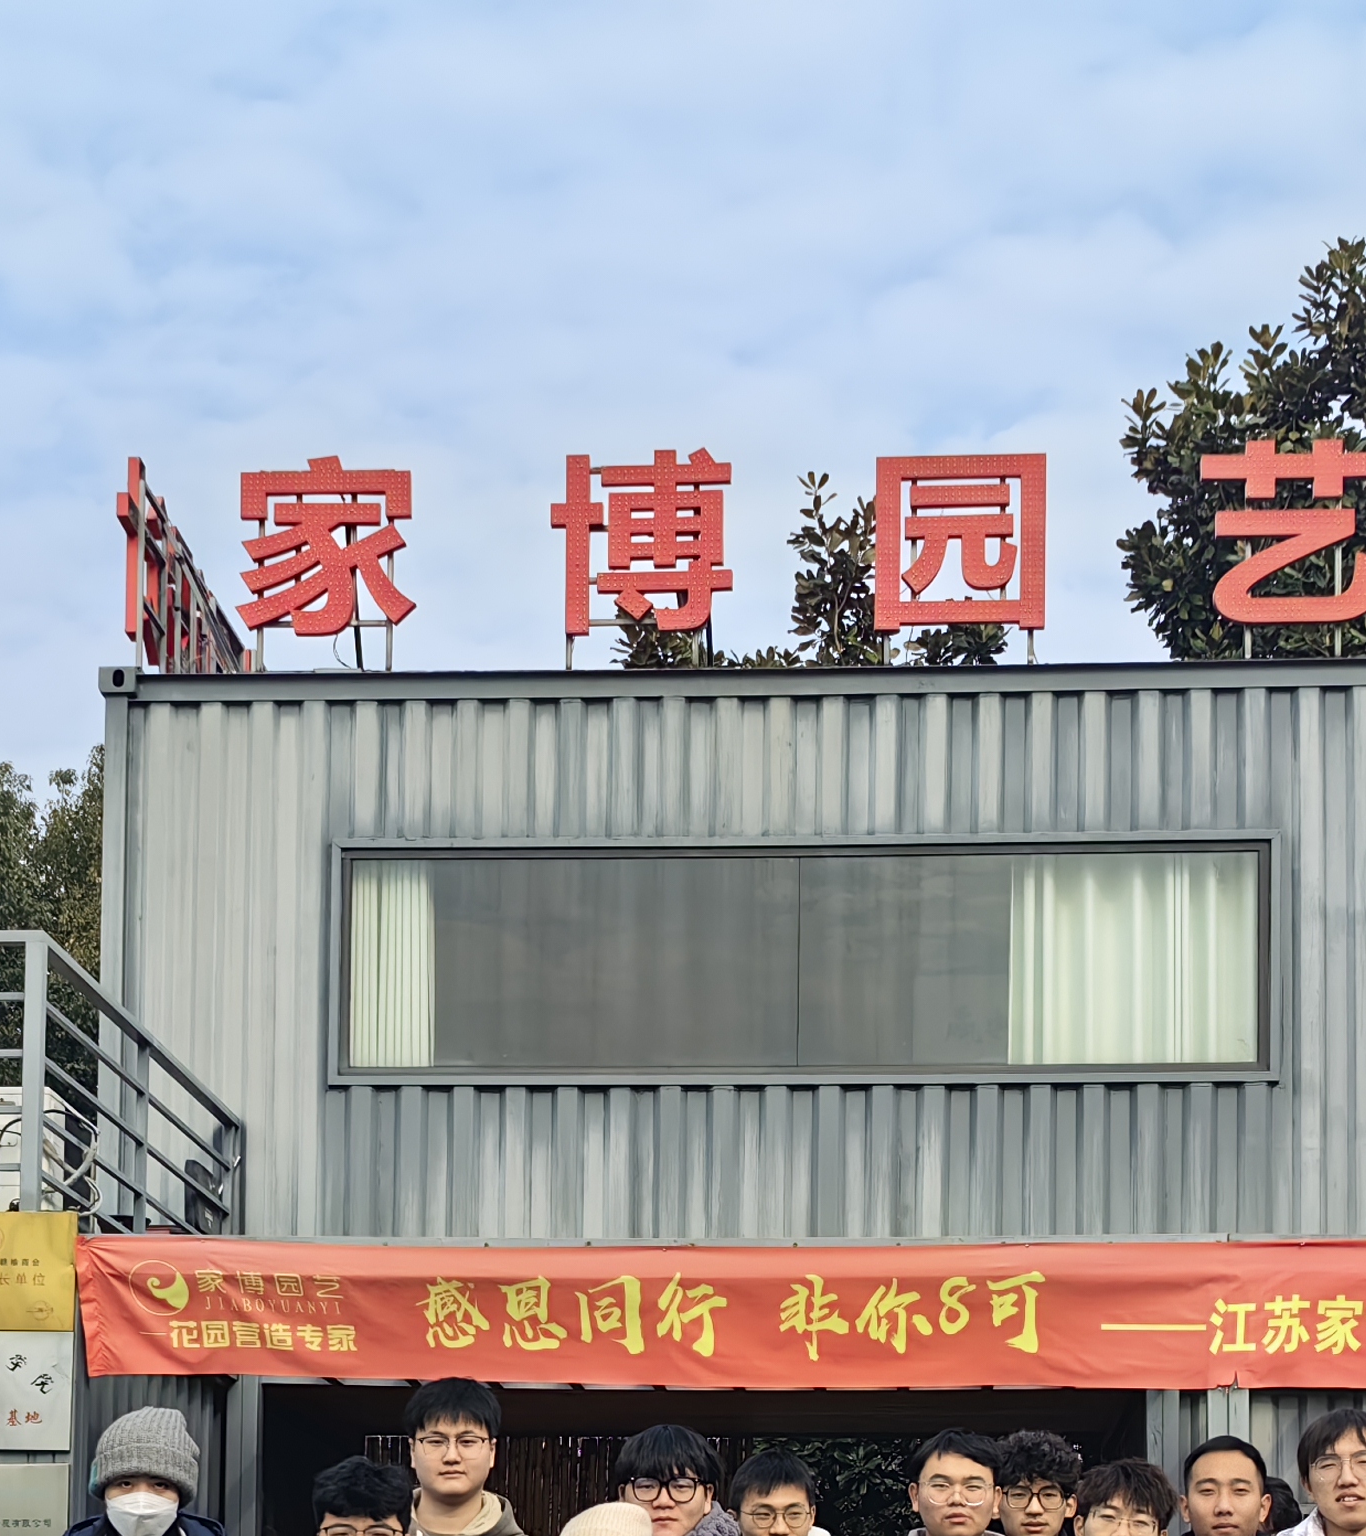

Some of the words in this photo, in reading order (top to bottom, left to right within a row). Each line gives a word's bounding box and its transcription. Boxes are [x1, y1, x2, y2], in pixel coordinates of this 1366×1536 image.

[195, 1269, 344, 1299] 家博园艺
[415, 1272, 728, 1357] 感恩同行
[170, 1319, 358, 1352] 花园营造专家
